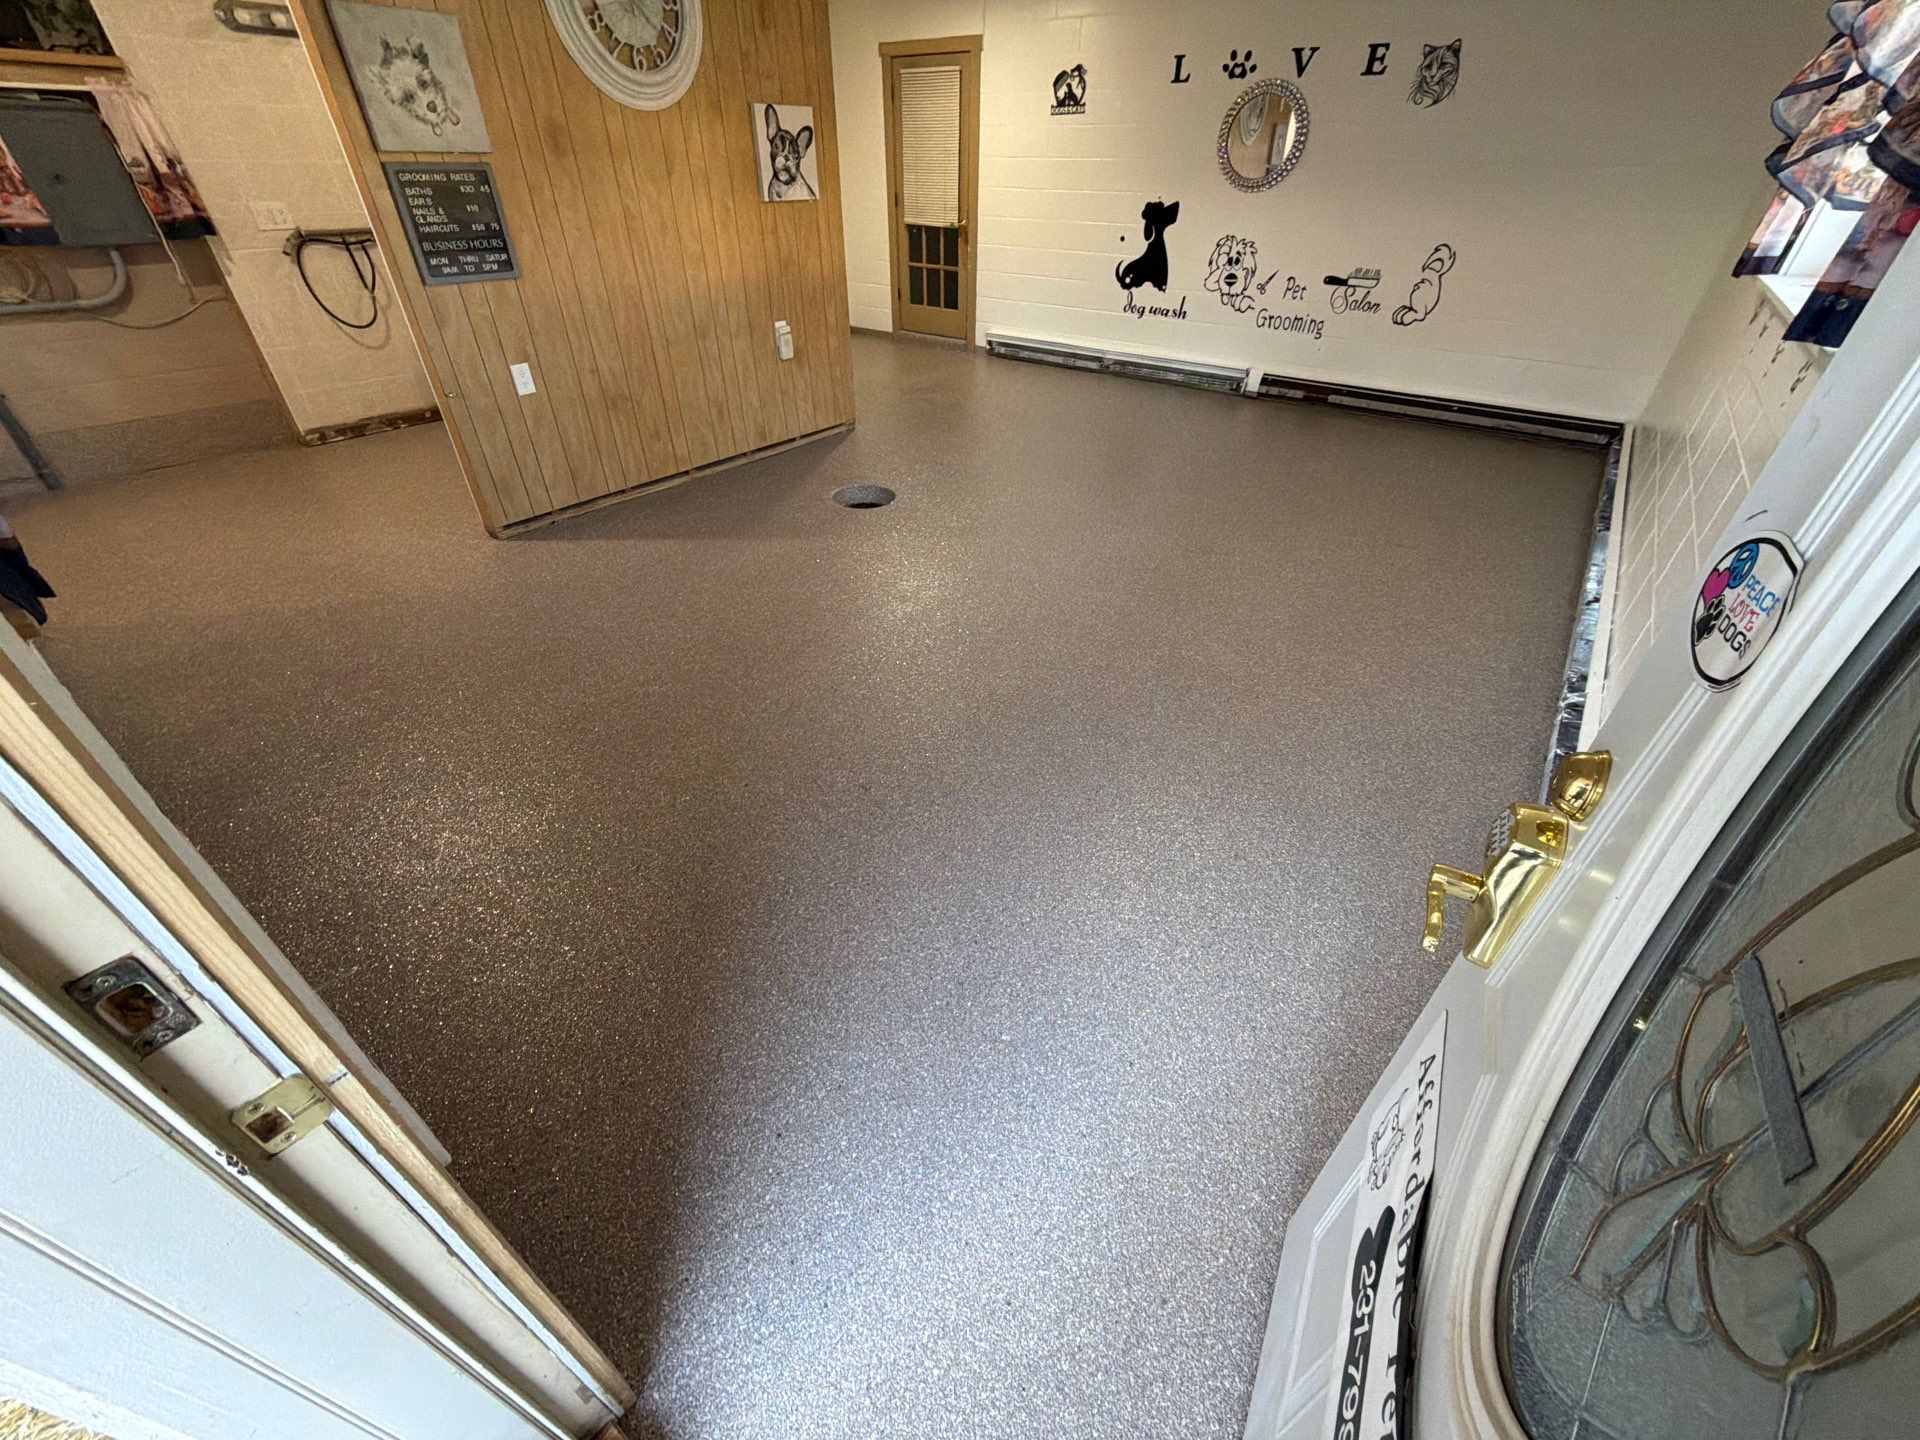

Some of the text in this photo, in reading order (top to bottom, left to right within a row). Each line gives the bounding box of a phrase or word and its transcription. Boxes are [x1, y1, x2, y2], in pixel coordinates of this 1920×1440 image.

[398, 172, 476, 182] GROOMING RATES
[404, 185, 491, 196] BATHS $30 45
[408, 198, 433, 206] EARS
[412, 207, 436, 215] NAILS
[438, 207, 445, 215] &
[415, 215, 448, 224] GLANDS
[419, 222, 500, 233] HAIRCUTS $50 75
[422, 238, 504, 251] BUSINESS HOURS
[430, 253, 508, 266] MON THRU SATUR
[442, 263, 499, 274] 9AM TO 5PM
[1283, 276, 1308, 300] Pet
[1123, 291, 1188, 319] dog wash
[1330, 286, 1382, 314] Salon
[1256, 308, 1325, 340] Grooming
[1742, 574, 1781, 618] PEACE
[1728, 592, 1760, 633] LOVE
[1717, 615, 1752, 660] DOGS
